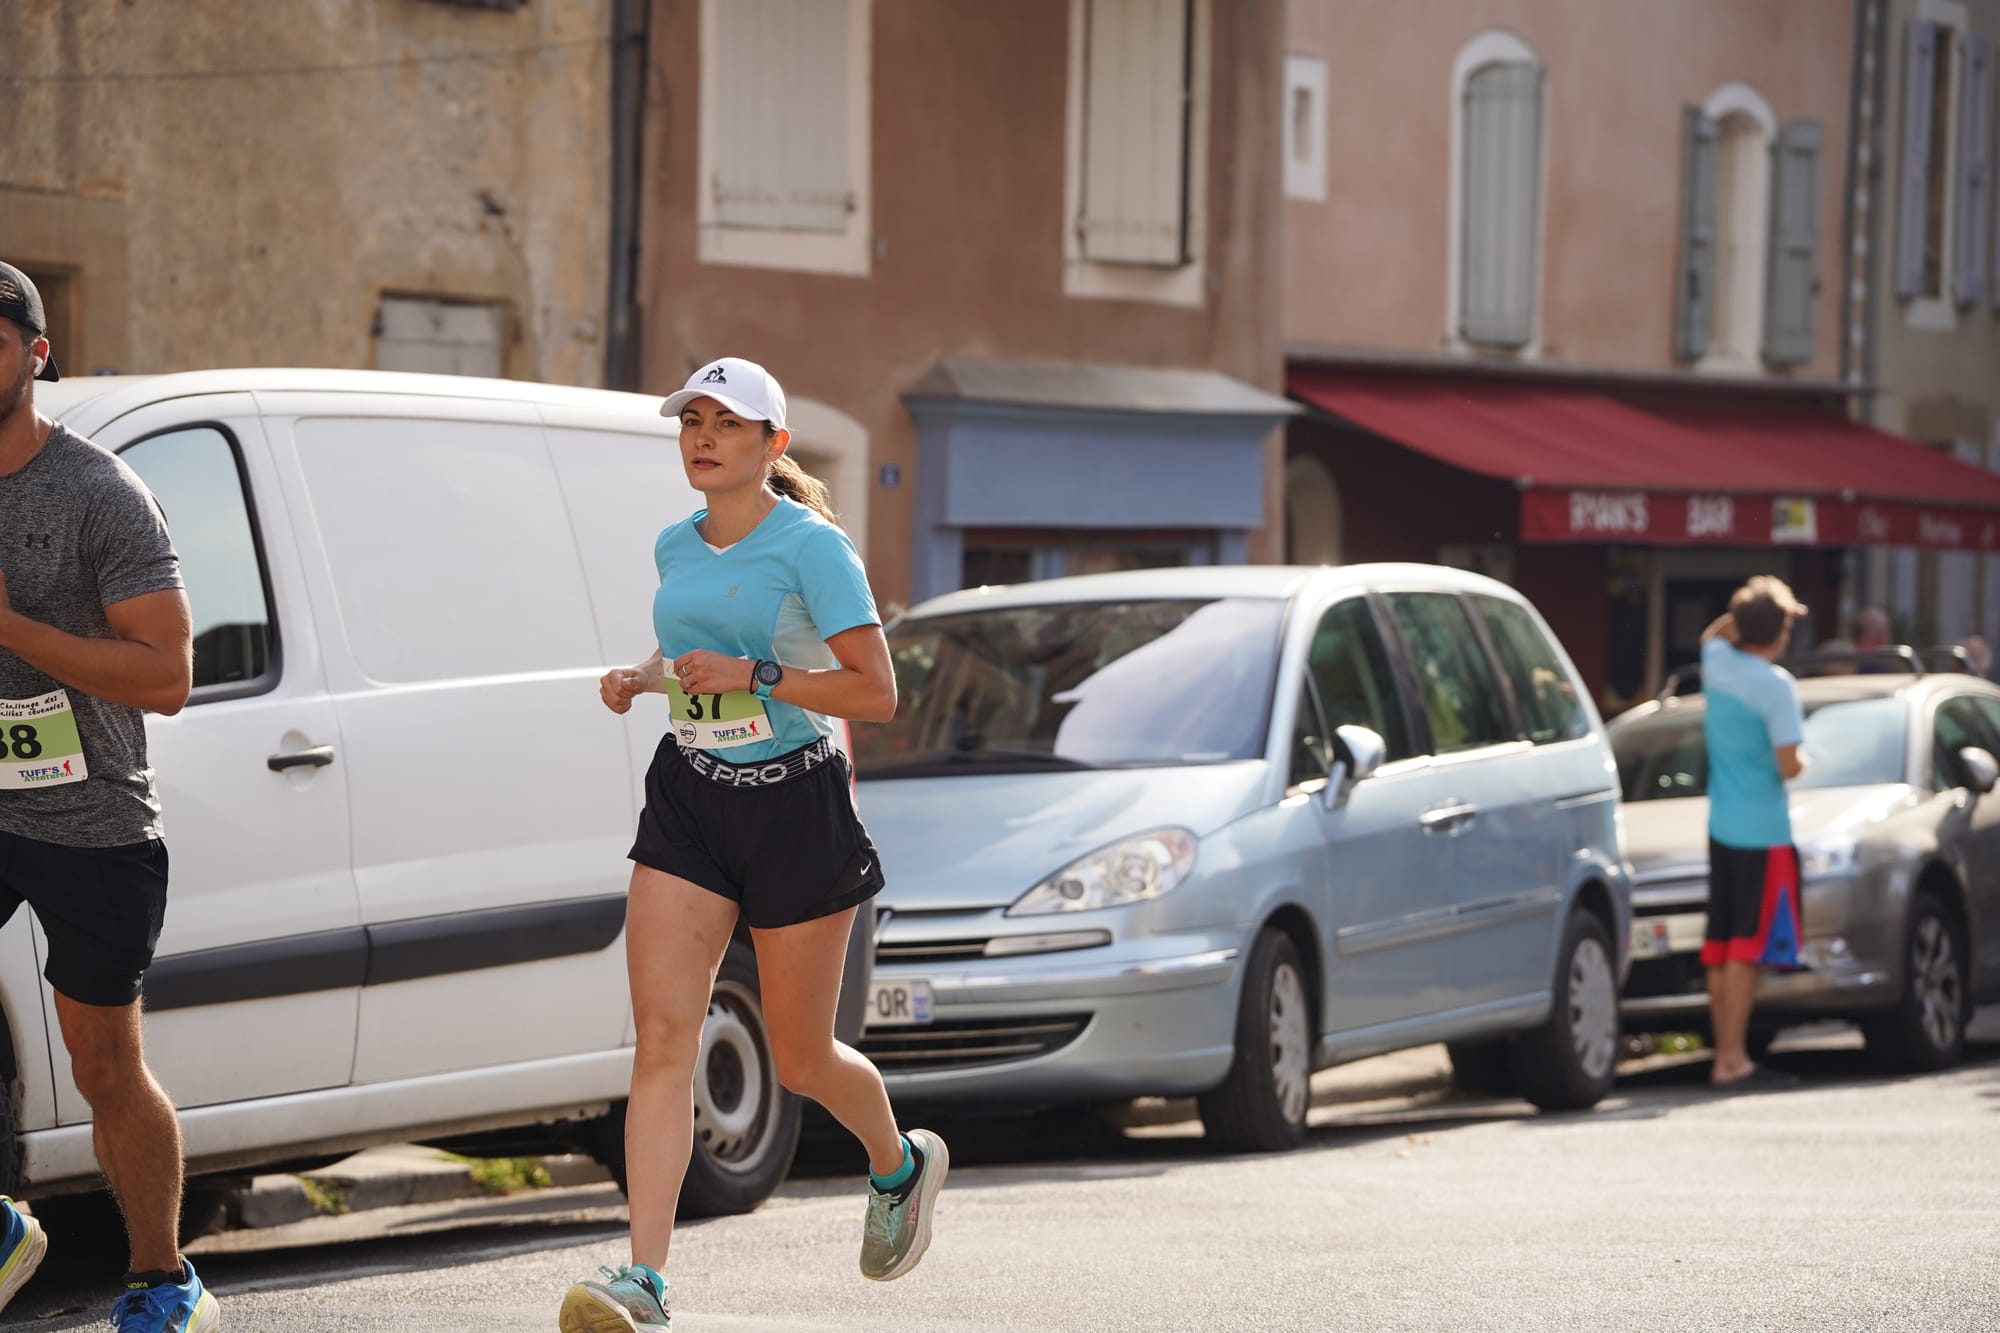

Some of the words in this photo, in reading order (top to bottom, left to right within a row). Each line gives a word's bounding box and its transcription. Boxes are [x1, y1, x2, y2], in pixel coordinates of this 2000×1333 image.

[0, 701, 39, 710] Challenge
[44, 695, 57, 704] des
[683, 690, 722, 720] 37
[712, 726, 747, 738] TUFF'S
[717, 732, 752, 743] Aventure
[18, 766, 60, 778] TUFF'S
[24, 771, 65, 783] Aventure
[711, 763, 788, 787] PRO
